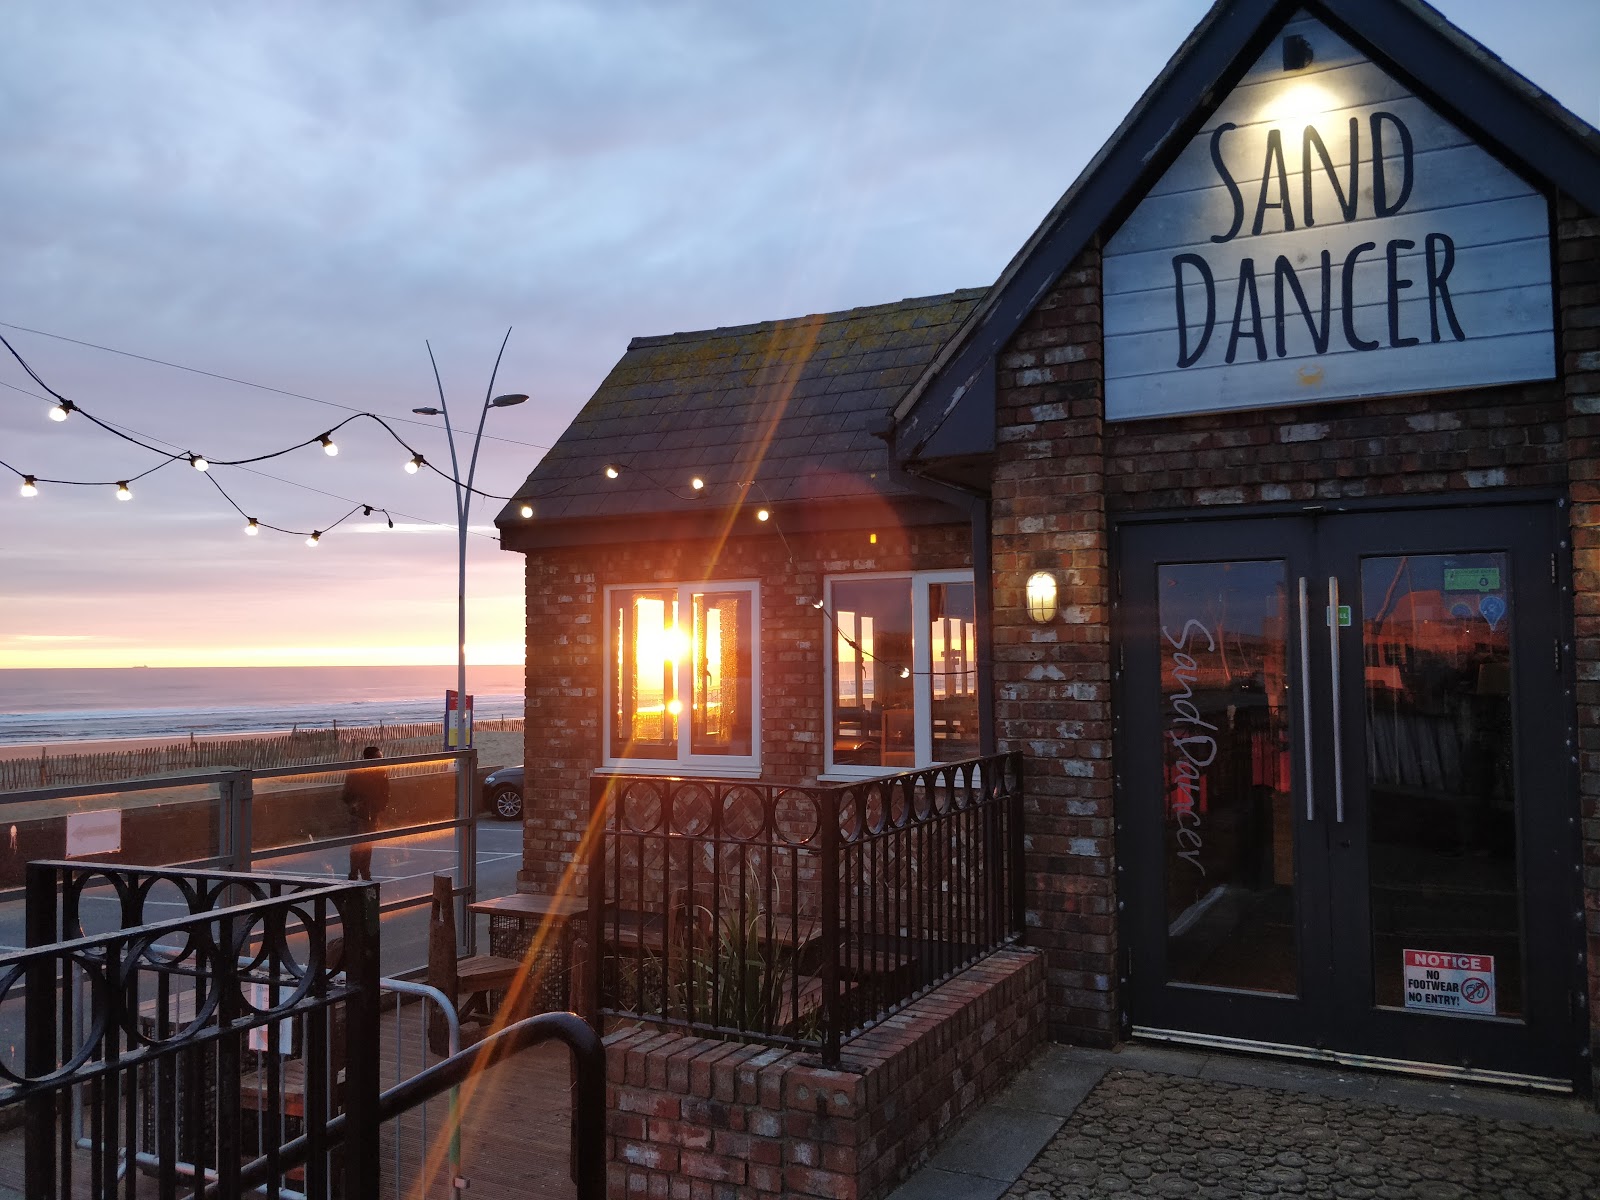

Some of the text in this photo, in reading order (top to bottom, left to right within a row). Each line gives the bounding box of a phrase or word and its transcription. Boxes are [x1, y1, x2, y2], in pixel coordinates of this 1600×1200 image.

[1210, 112, 1413, 243] SAND
[1172, 232, 1465, 369] DANCER
[1414, 954, 1481, 970] NOTICE
[1426, 970, 1440, 980] NO
[1408, 978, 1459, 993] FOOTWEAR
[1408, 992, 1460, 1006] NO ENTRY!
